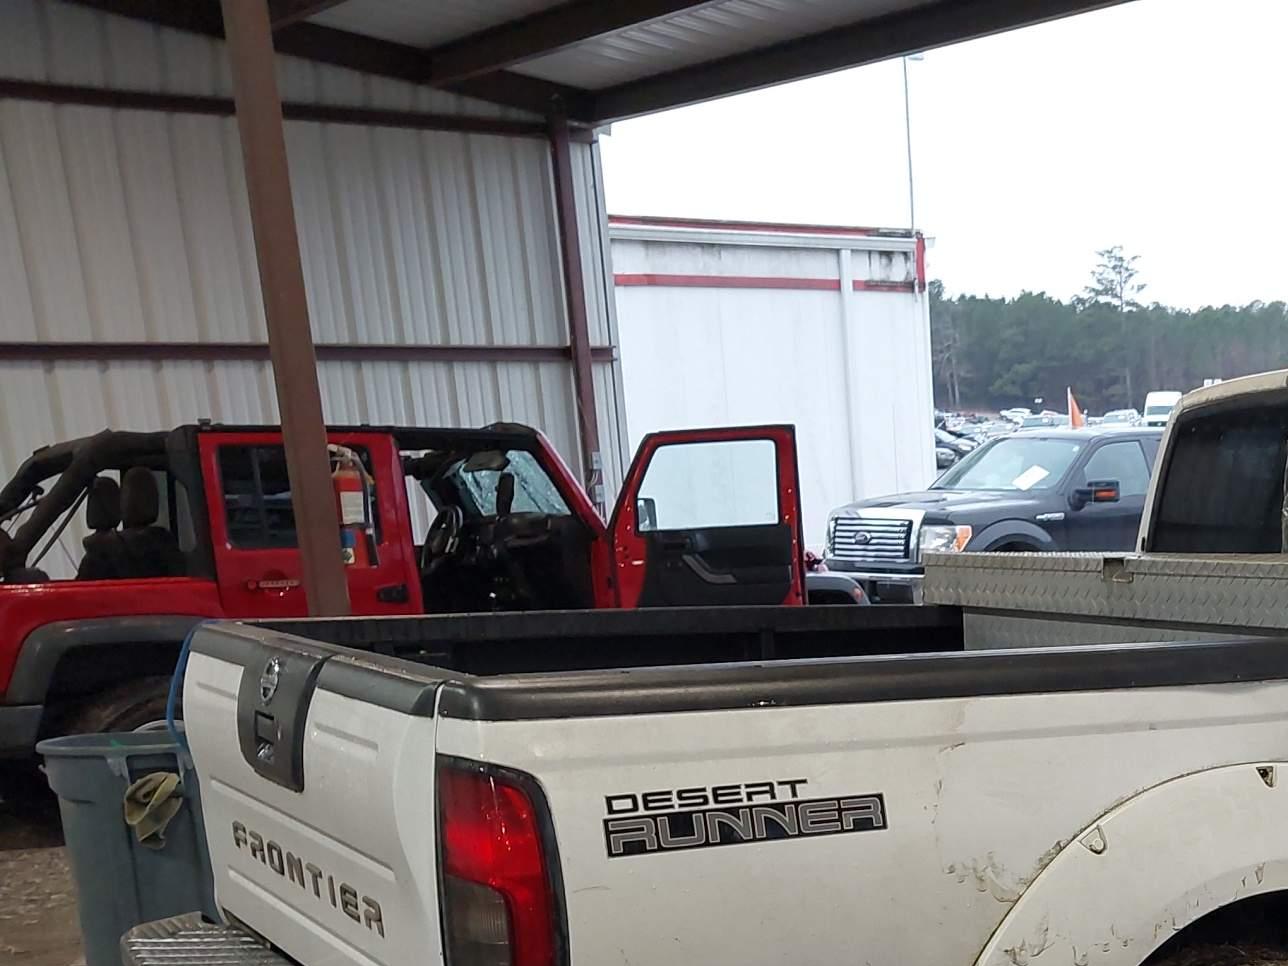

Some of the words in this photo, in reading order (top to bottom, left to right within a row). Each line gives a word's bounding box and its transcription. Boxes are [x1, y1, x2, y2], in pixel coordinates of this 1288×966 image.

[604, 779, 808, 815] DESERT
[605, 796, 884, 856] RUNNER
[231, 820, 385, 938] FRONTIER
